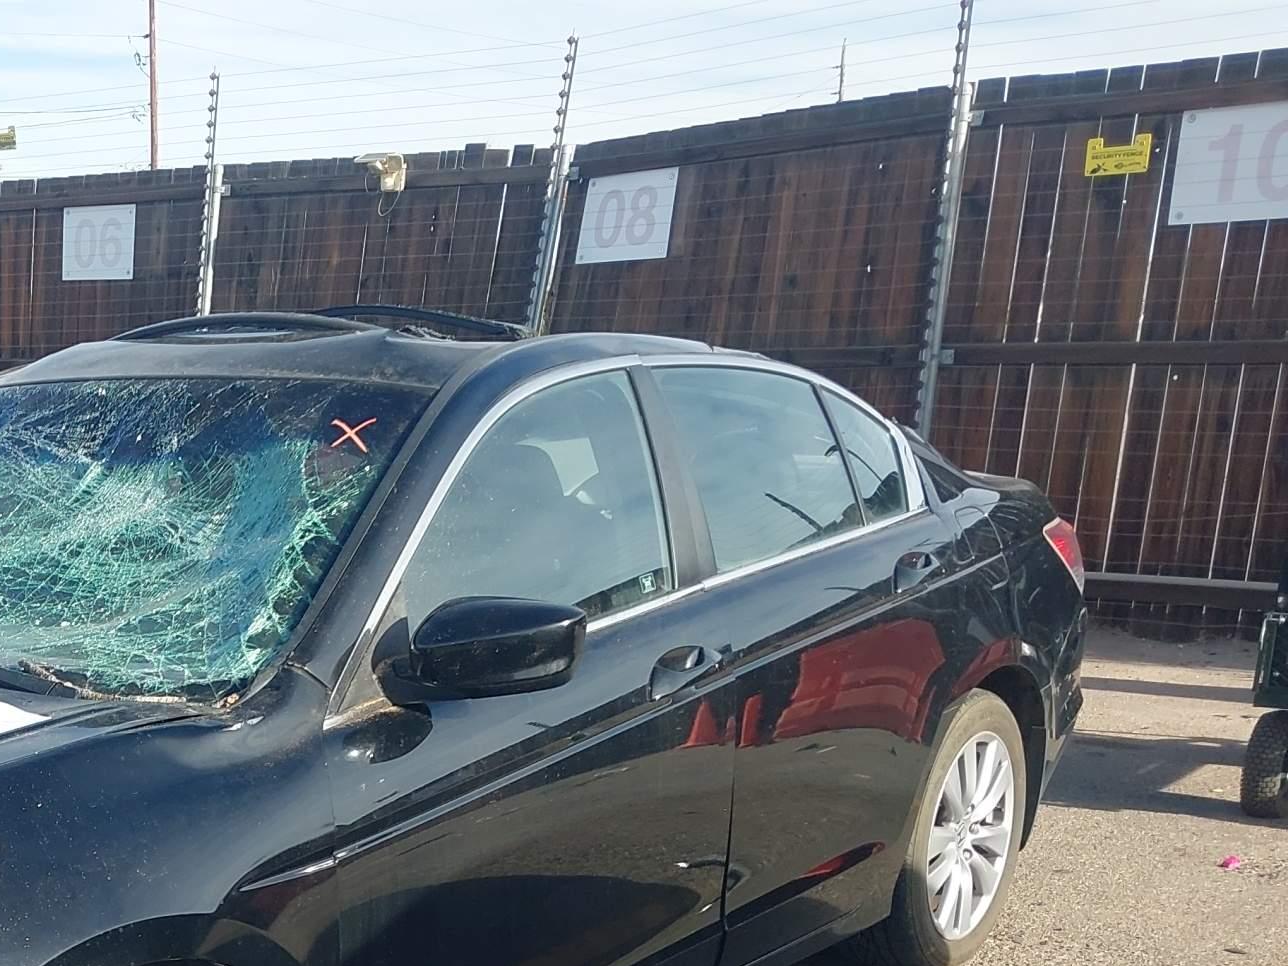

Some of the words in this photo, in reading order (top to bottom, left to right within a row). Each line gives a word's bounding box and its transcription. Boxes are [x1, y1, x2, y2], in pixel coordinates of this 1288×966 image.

[1122, 150, 1144, 158] FENCE
[594, 185, 658, 248] 08
[74, 217, 122, 268] 06
